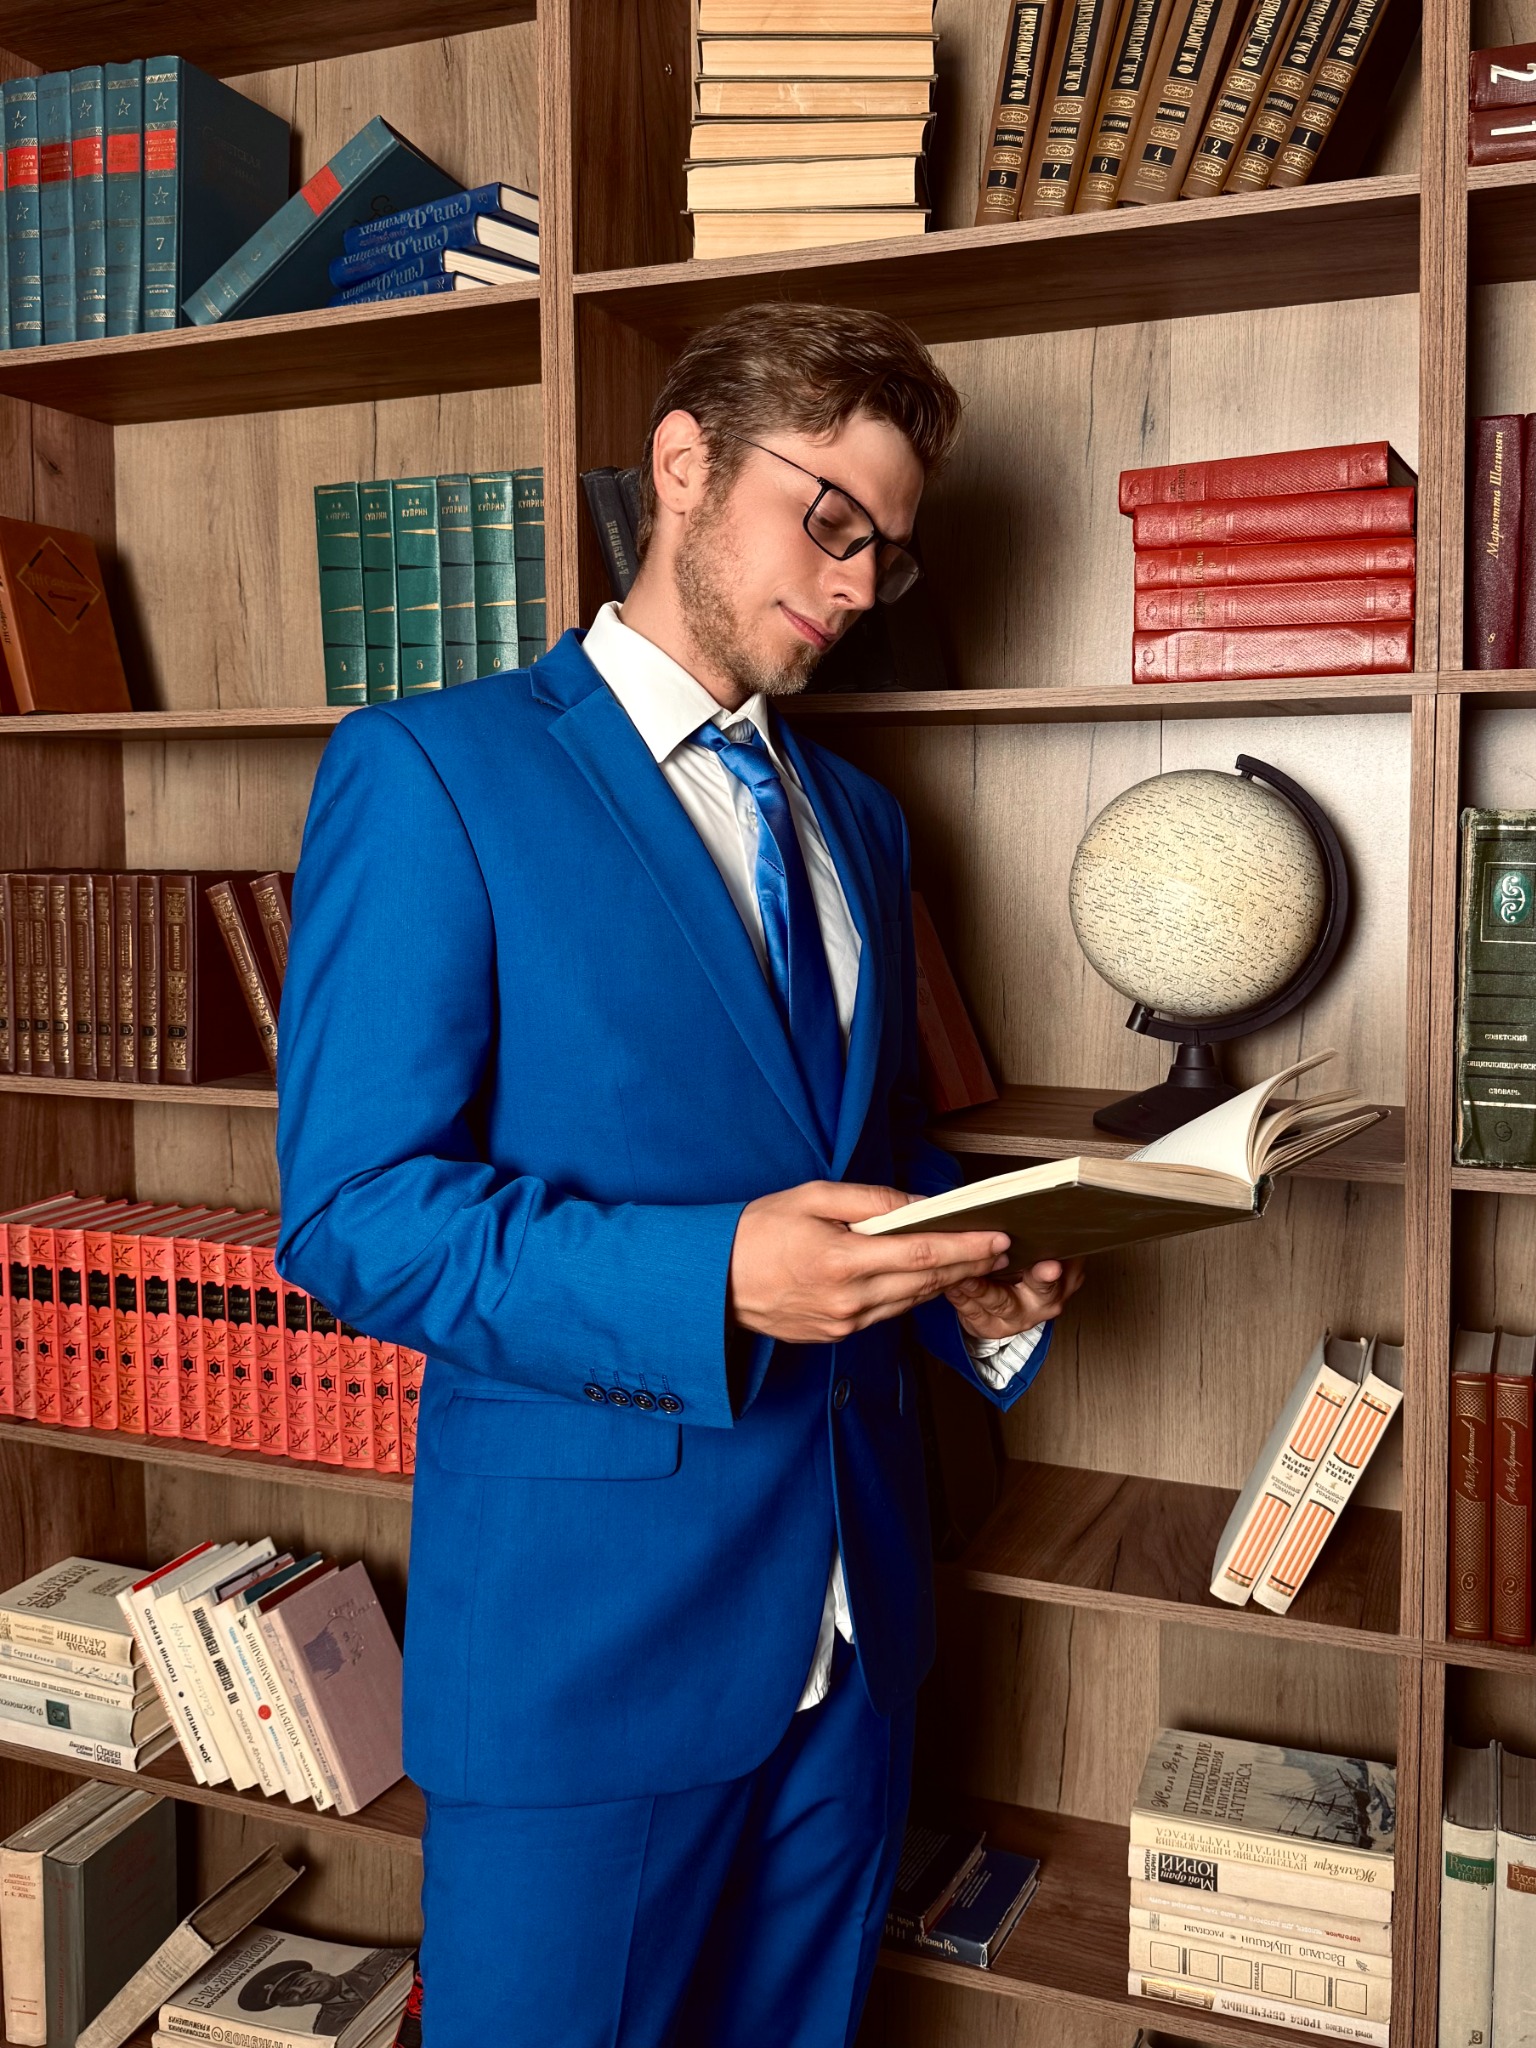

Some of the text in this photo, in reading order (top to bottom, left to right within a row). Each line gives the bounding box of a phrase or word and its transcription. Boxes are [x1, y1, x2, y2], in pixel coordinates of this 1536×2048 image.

[1490, 63, 1536, 84] 2
[1490, 120, 1536, 136] 1
[1210, 139, 1222, 155] 2
[1257, 137, 1268, 152] 3
[1303, 131, 1312, 146] 1
[1153, 147, 1163, 161] 4
[1052, 164, 1061, 178] 7
[1100, 157, 1109, 172] 6
[999, 172, 1007, 185] 5
[156, 237, 164, 250] 7
[1487, 431, 1504, 558] Мариэтта Шагинян
[401, 508, 428, 518] КУПРИН
[441, 505, 469, 515] КУПРИН
[477, 503, 506, 512] КУПРИН
[416, 660, 424, 670] 5
[456, 659, 464, 670] 2
[492, 657, 501, 668] 6
[1484, 1033, 1528, 1042] СОВЕТСКИЙ
[1488, 1087, 1521, 1096] СЛОВАРЬ
[1281, 1460, 1308, 1478] ТВЕН
[1283, 1453, 1312, 1472] МАРК
[1326, 1460, 1355, 1479] МАРК
[1325, 1466, 1352, 1485] ТВЕН
[1464, 1574, 1474, 1590] 3
[1504, 1578, 1516, 1594] 2
[56, 1629, 107, 1650] САБАТИНИ
[192, 1606, 220, 1657] НЕВИДИМОК
[67, 1641, 106, 1658] РАФАЭЛЬ
[144, 1608, 178, 1683] ГЕОРГИЙ БЕРЕЗКО
[246, 1632, 279, 1697] ШВАМБРАНИЯ
[225, 1691, 240, 1705] ПО
[277, 1702, 300, 1748] КОНДУИТ
[183, 1705, 213, 1764] ДОМ УЧИТЕЛЯ
[1161, 1743, 1189, 1774] Верн
[1183, 1741, 1212, 1814] ПУТЕШЕСТВИЕ
[1200, 1750, 1224, 1816] И ПРИКЛЮЧЕНИЯ
[1214, 1771, 1234, 1818] КАПИТАНА
[1228, 1763, 1253, 1821] ГАТТЕРАСА
[1155, 1836, 1224, 1856] ПРИКЛЮЧЕНИЯ
[1156, 1827, 1307, 1863] КАПИТАНА ГАТТЕРАСА
[1160, 1853, 1215, 1878] ЮРИЙ
[1237, 1852, 1307, 1871] ПУТЕШЕСТВИЕ
[1160, 1868, 1215, 1892] Мой брат
[1183, 1923, 1346, 1967] Василий Шукшин РАССКАЗЫ
[1220, 1998, 1285, 2022] ОБРЕЧЕННЫХ
[1290, 2013, 1321, 2029] ТРОПА
